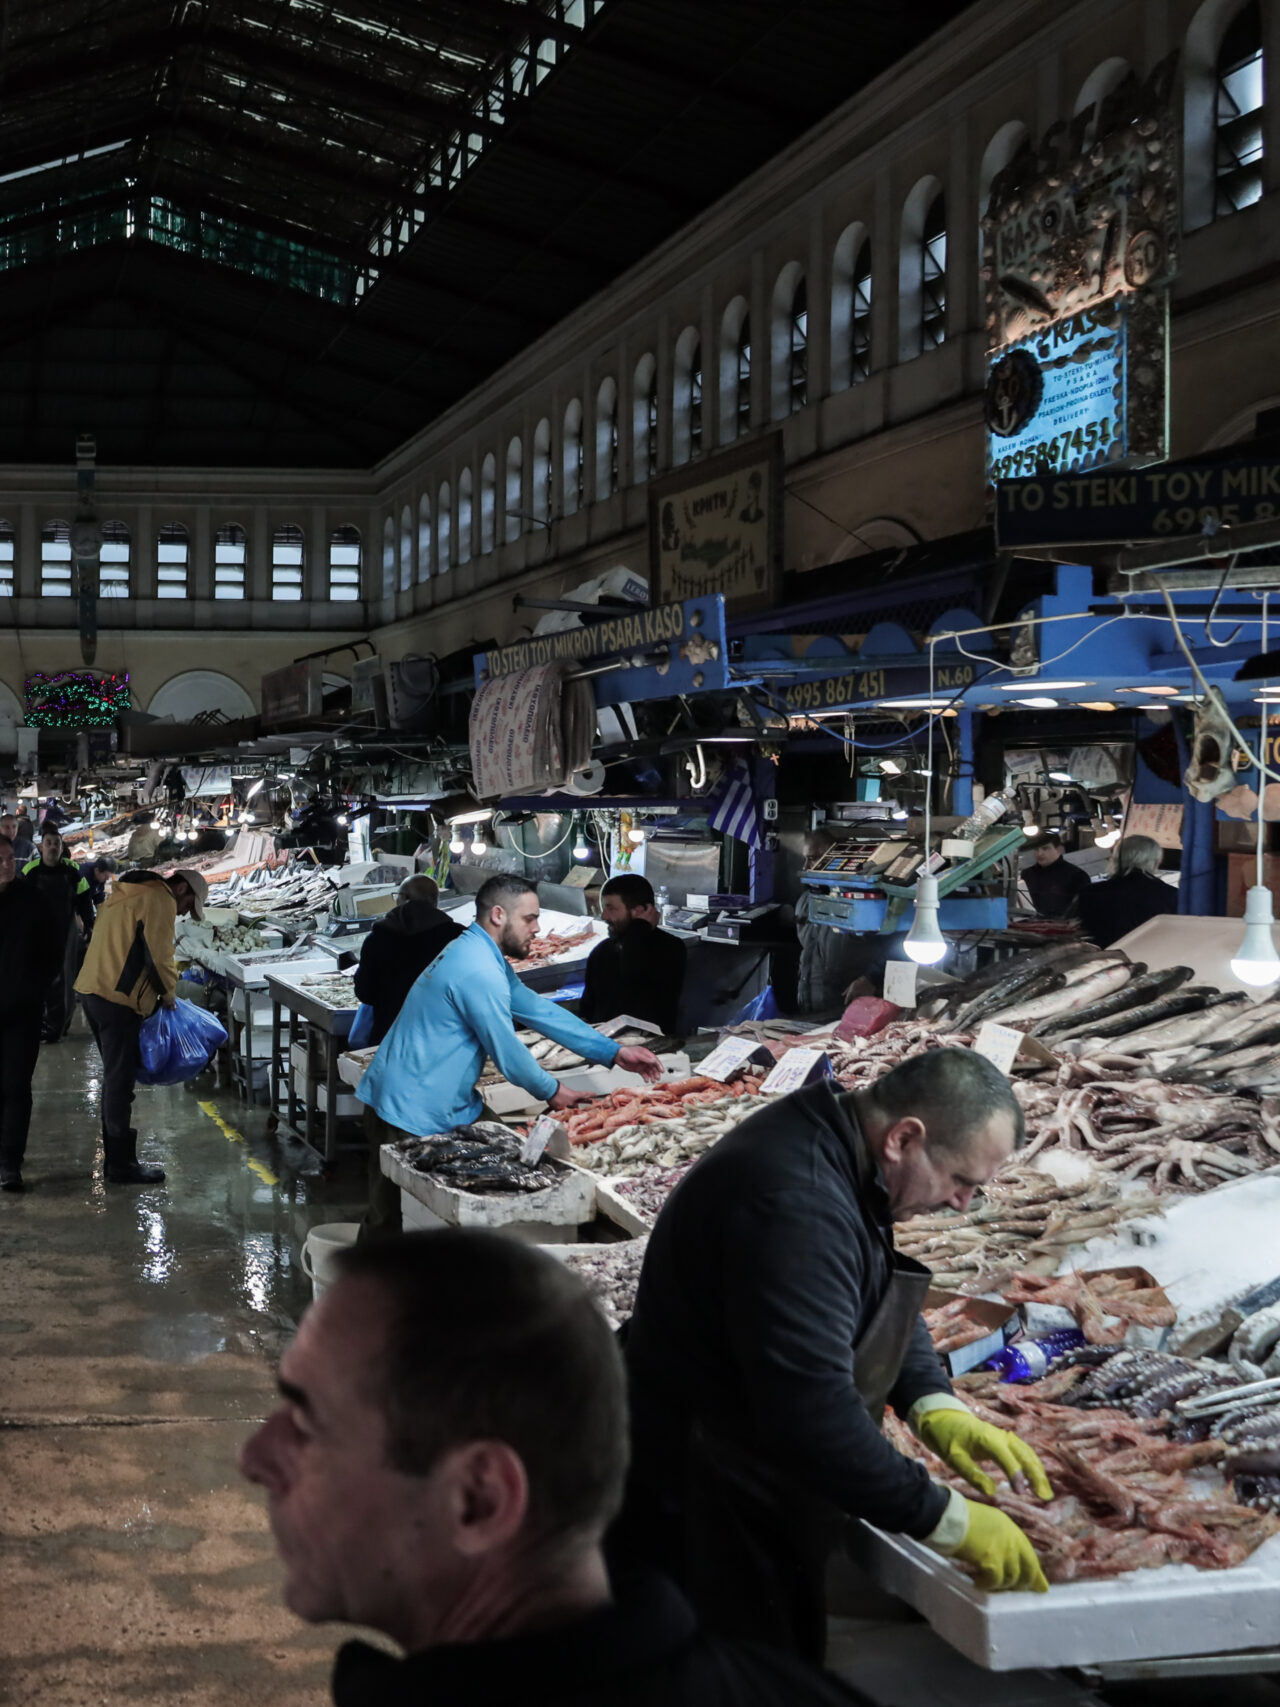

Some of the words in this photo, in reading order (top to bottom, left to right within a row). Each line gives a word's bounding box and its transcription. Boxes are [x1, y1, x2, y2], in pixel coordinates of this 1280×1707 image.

[1001, 484, 1045, 512] TO
[1051, 476, 1137, 510] STEKI
[1146, 470, 1213, 502] TOY
[486, 650, 501, 678] TO
[502, 643, 530, 674] STEKI
[530, 637, 553, 664] TOY
[554, 625, 599, 660] MIKROY
[601, 616, 643, 652] PSARA
[644, 603, 684, 642] KASO
[786, 680, 821, 709] 6995
[825, 673, 855, 703] 867
[858, 669, 886, 698] 451
[937, 667, 973, 687] N.60
